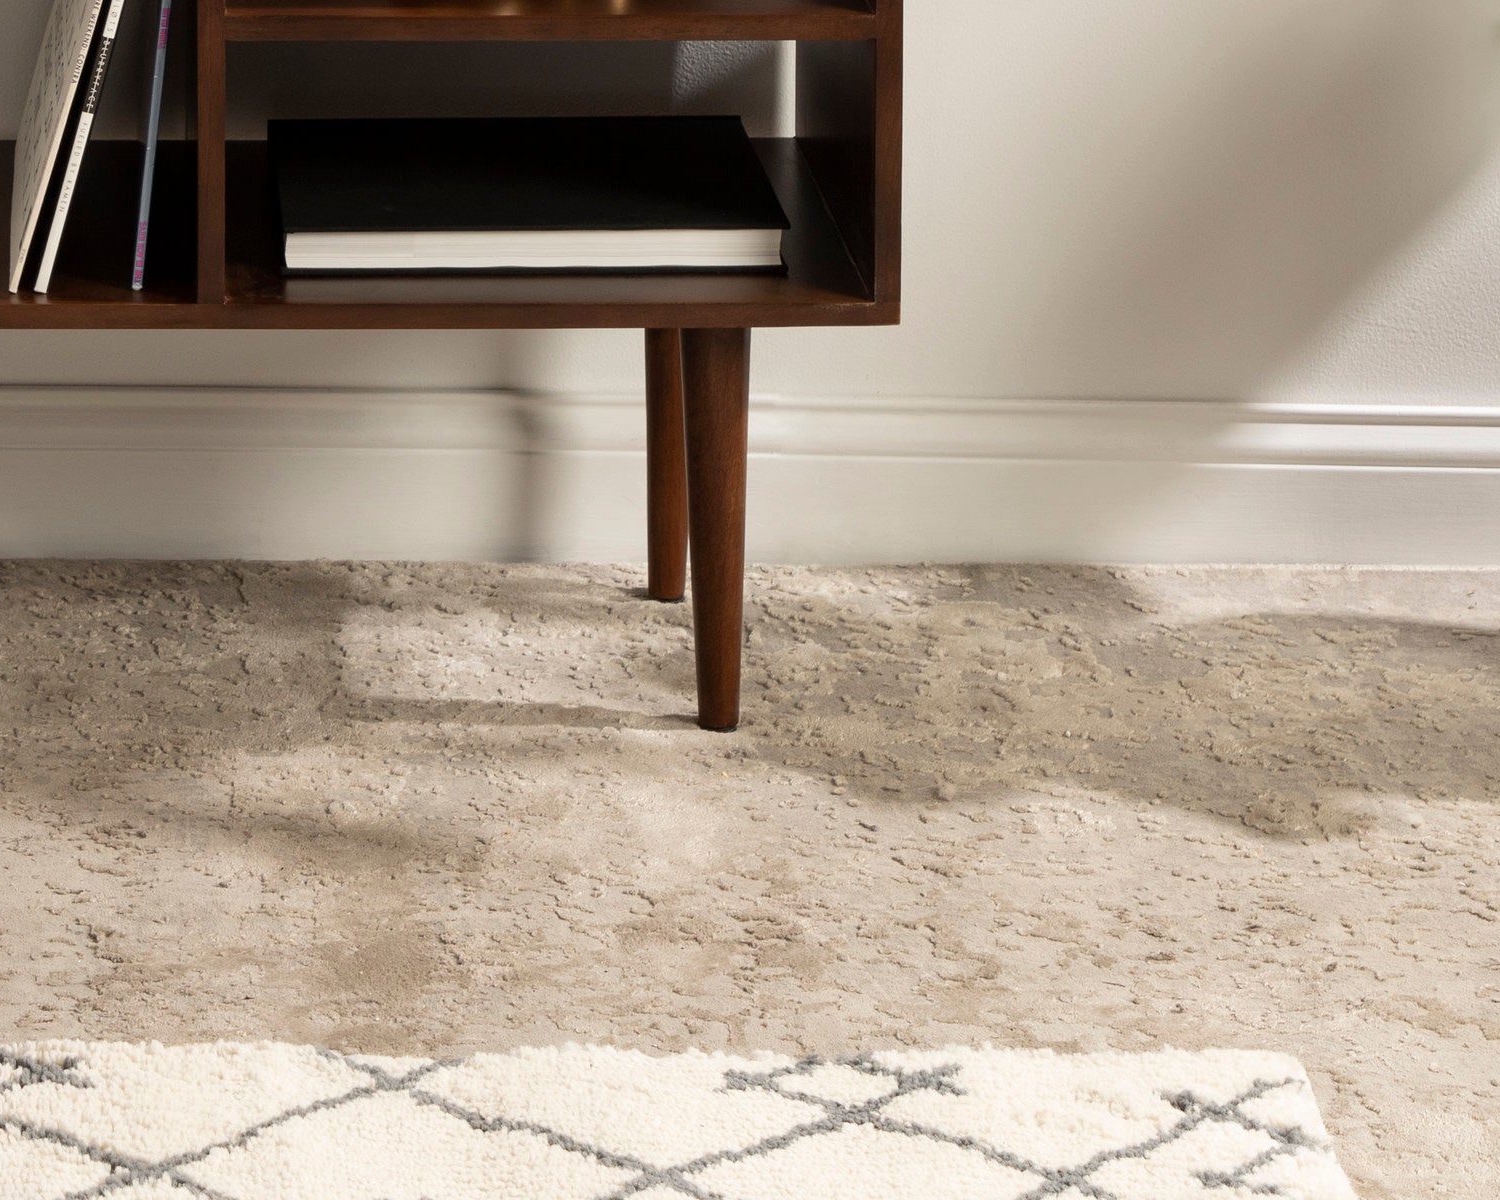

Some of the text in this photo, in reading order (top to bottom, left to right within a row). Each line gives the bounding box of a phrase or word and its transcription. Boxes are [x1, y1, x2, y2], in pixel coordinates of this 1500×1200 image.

[70, 53, 85, 85] CONTRA
[74, 121, 88, 157] FUELED
[69, 162, 77, 174] BY
[58, 179, 72, 213] RAMEN
